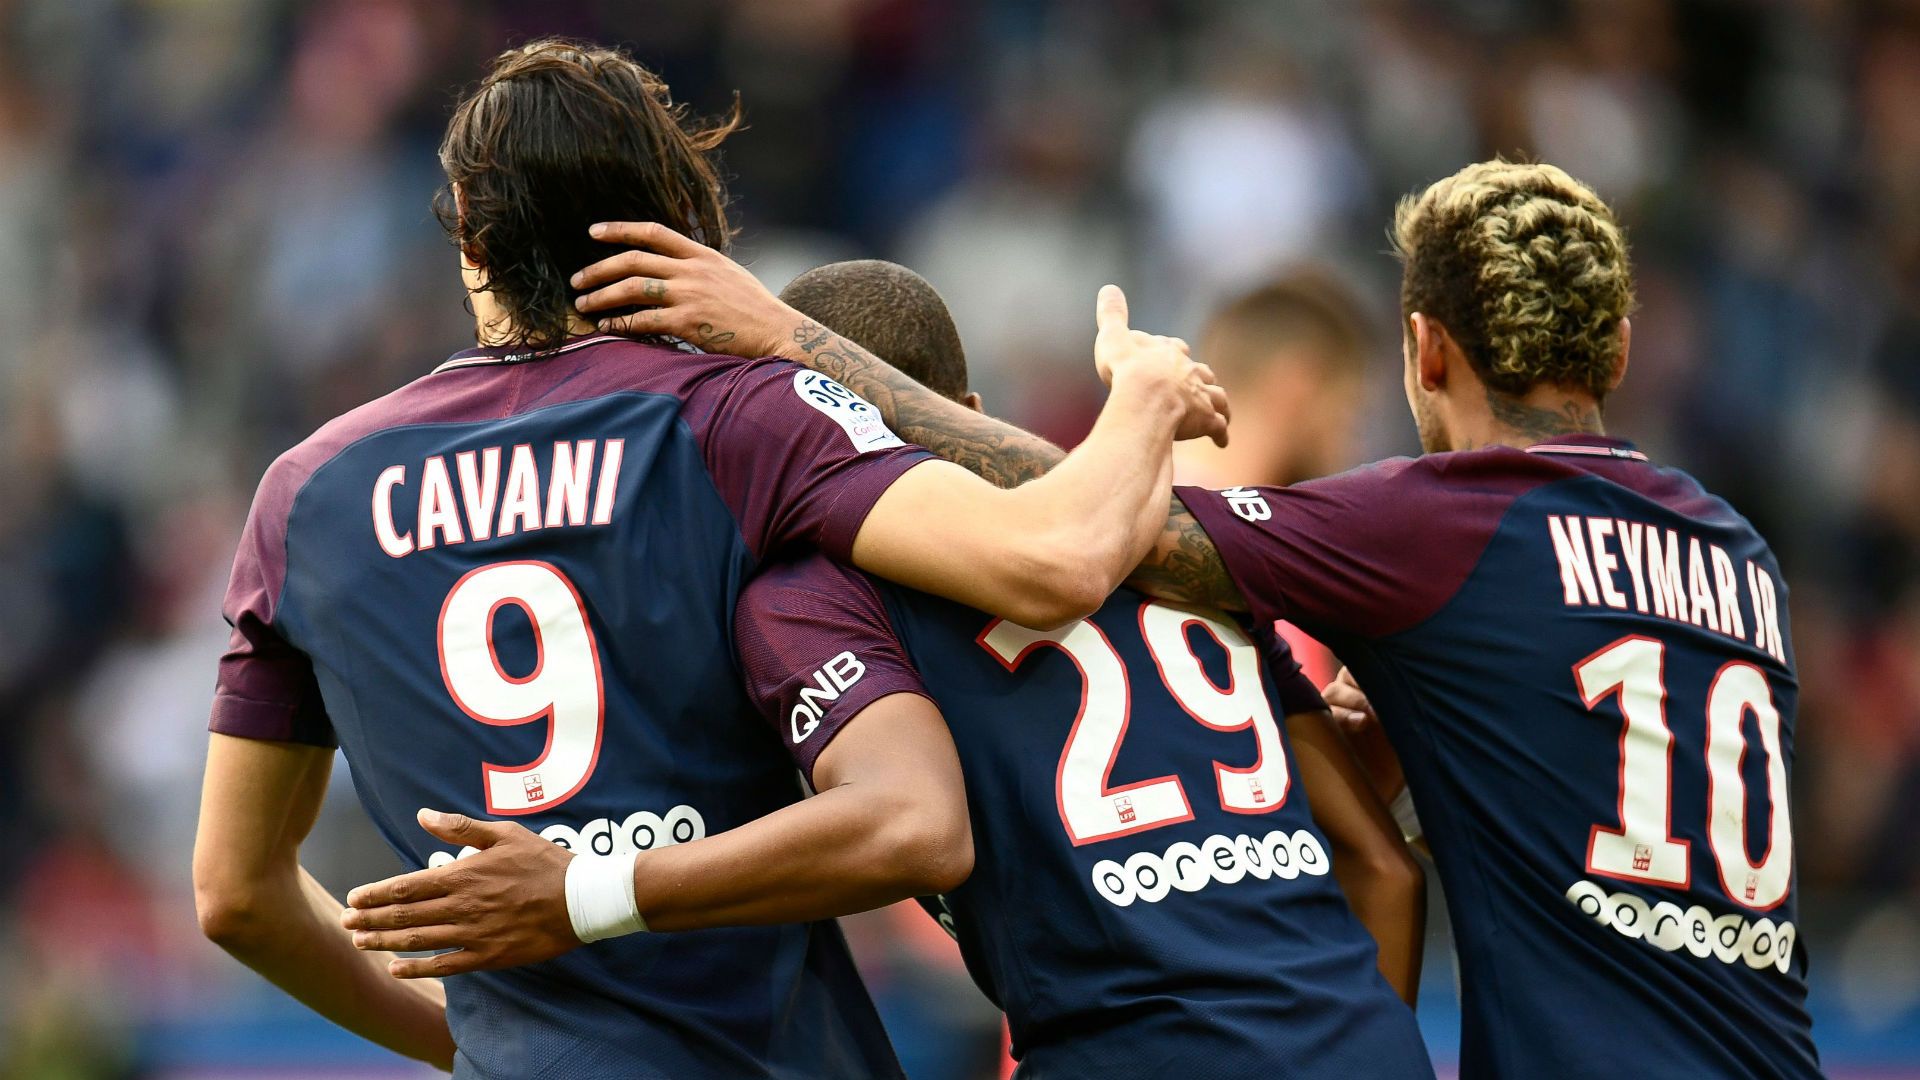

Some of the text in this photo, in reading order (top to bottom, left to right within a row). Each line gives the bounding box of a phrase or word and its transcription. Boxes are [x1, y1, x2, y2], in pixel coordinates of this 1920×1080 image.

[372, 438, 624, 558] CAVANI
[1220, 486, 1272, 522] NB
[1547, 514, 1786, 665] NEYMAR JR
[437, 560, 605, 816] 9
[790, 650, 866, 744] QNB
[976, 600, 1291, 847] 29
[1571, 633, 1793, 912] 10
[1092, 829, 1329, 906] ooredoo
[1566, 880, 1796, 973] ooredoo
